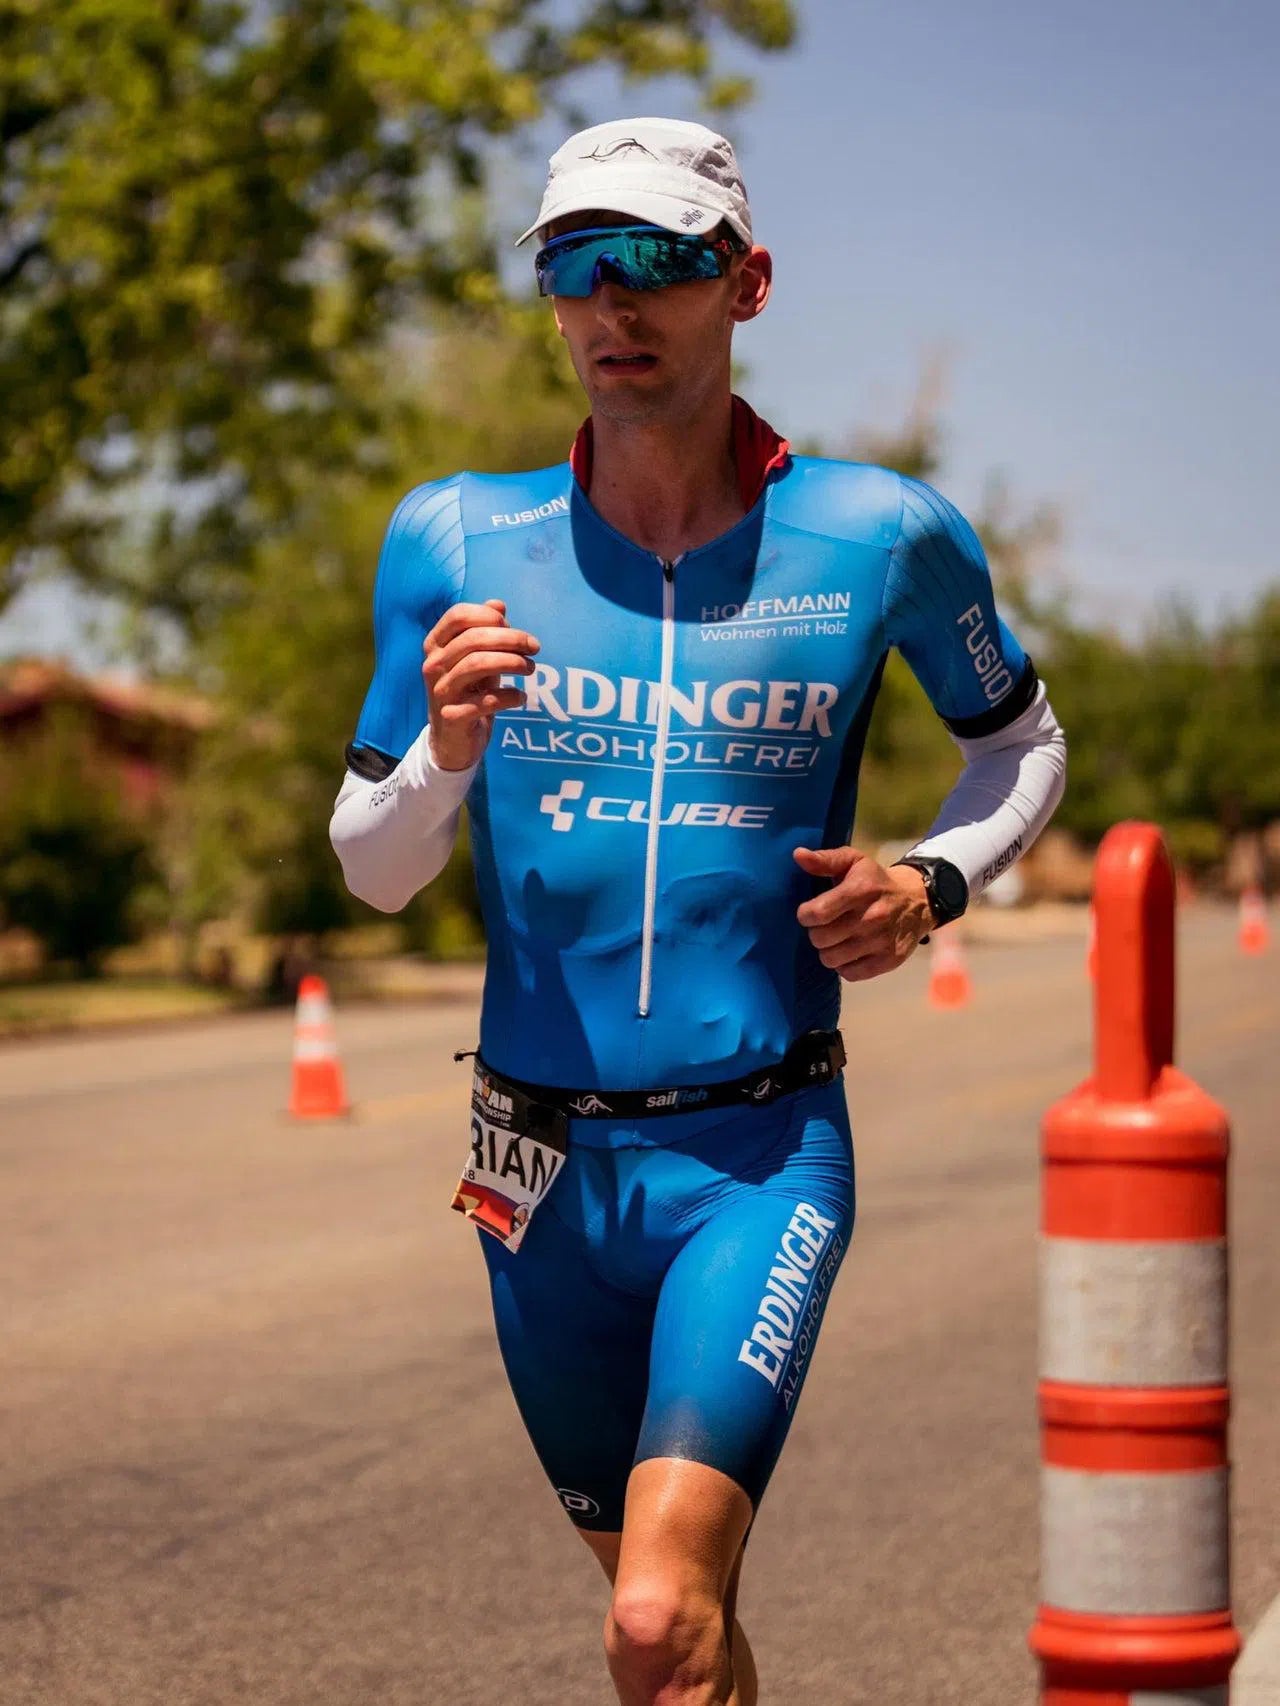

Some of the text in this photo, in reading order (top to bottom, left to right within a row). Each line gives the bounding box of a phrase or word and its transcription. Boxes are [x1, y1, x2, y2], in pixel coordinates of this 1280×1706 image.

[491, 495, 569, 526] FUSION
[701, 592, 850, 621] HOFFMANN
[701, 620, 848, 642] Wohnen mit Holz
[957, 603, 1014, 708] FUSIO
[502, 726, 820, 768] ALKOHOLFREI
[586, 799, 774, 828] CUBE
[982, 834, 1022, 886] FUSION
[645, 1088, 708, 1109] sailfish
[737, 1202, 836, 1387] ERDINGER
[783, 1233, 843, 1410] ALKOHOLFREI
